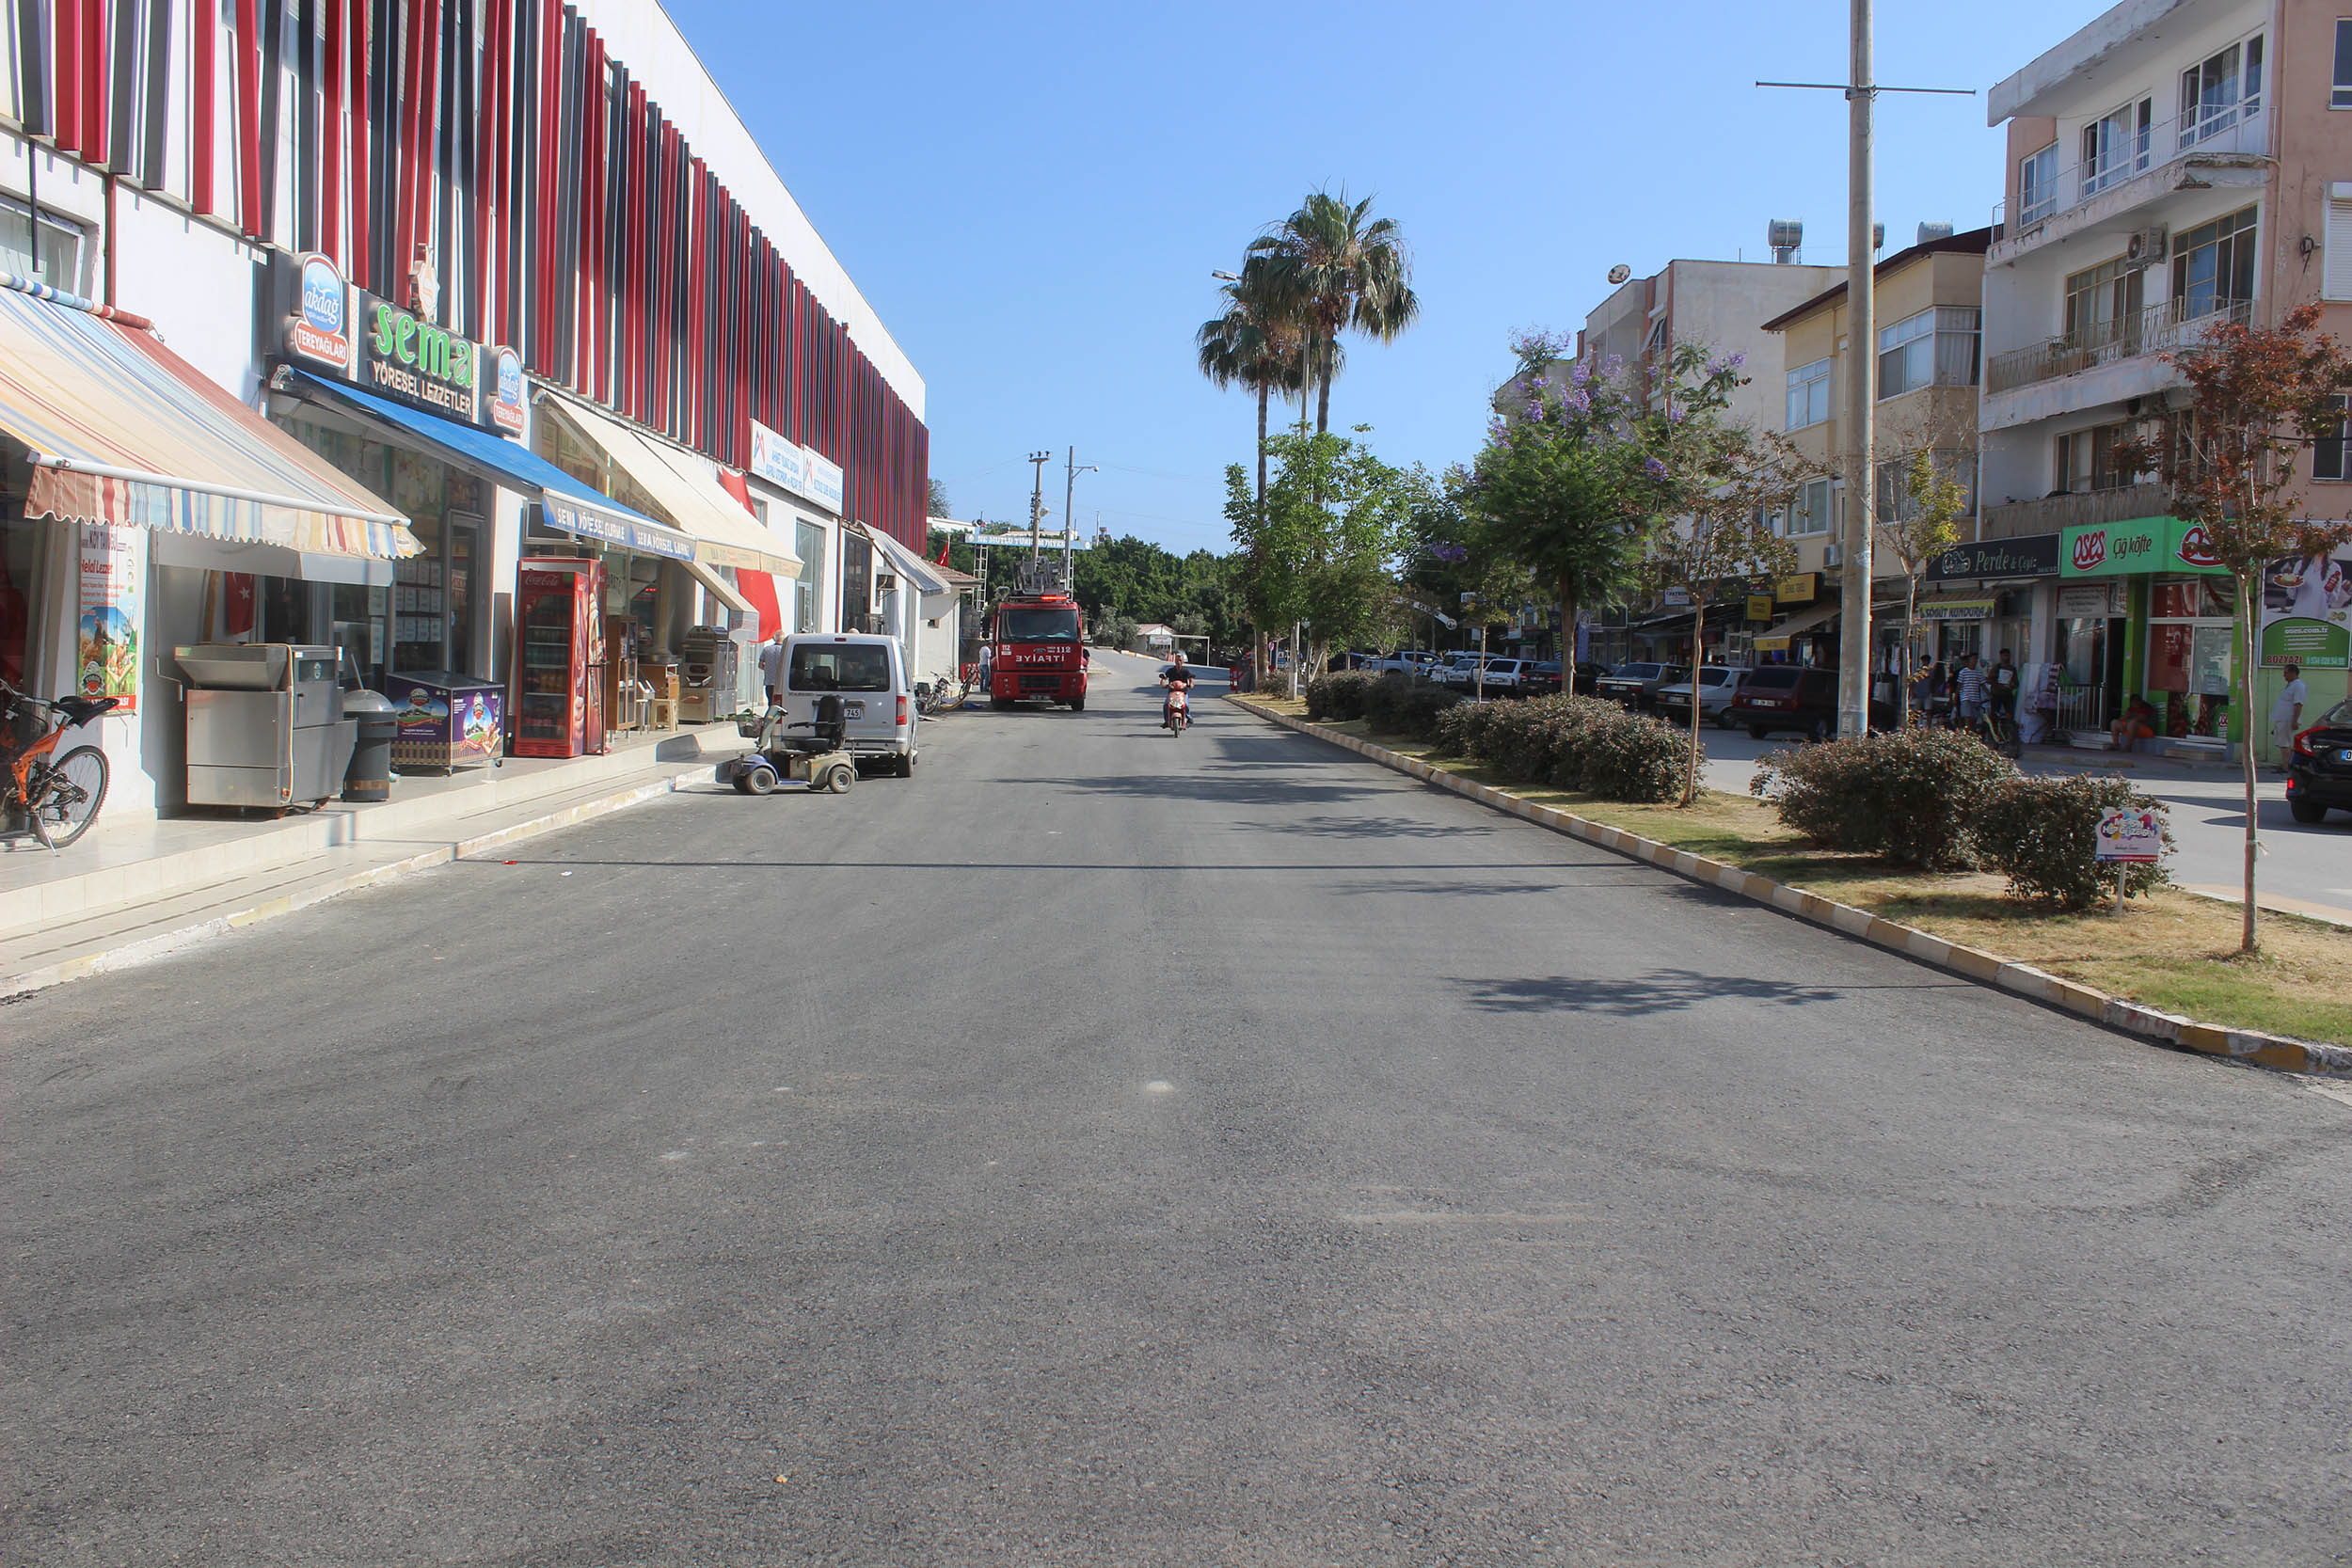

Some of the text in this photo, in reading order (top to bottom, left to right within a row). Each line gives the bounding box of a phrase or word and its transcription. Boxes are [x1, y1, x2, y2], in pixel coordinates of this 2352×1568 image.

[304, 286, 340, 325] akdağ
[297, 327, 346, 359] TEREYAĞLARI
[376, 304, 472, 388] sema
[373, 360, 471, 415] YÖRESEL LEZZETLER
[1976, 547, 2010, 573] Perde
[2113, 538, 2127, 560] Çiğ
[2129, 533, 2153, 557] köfte
